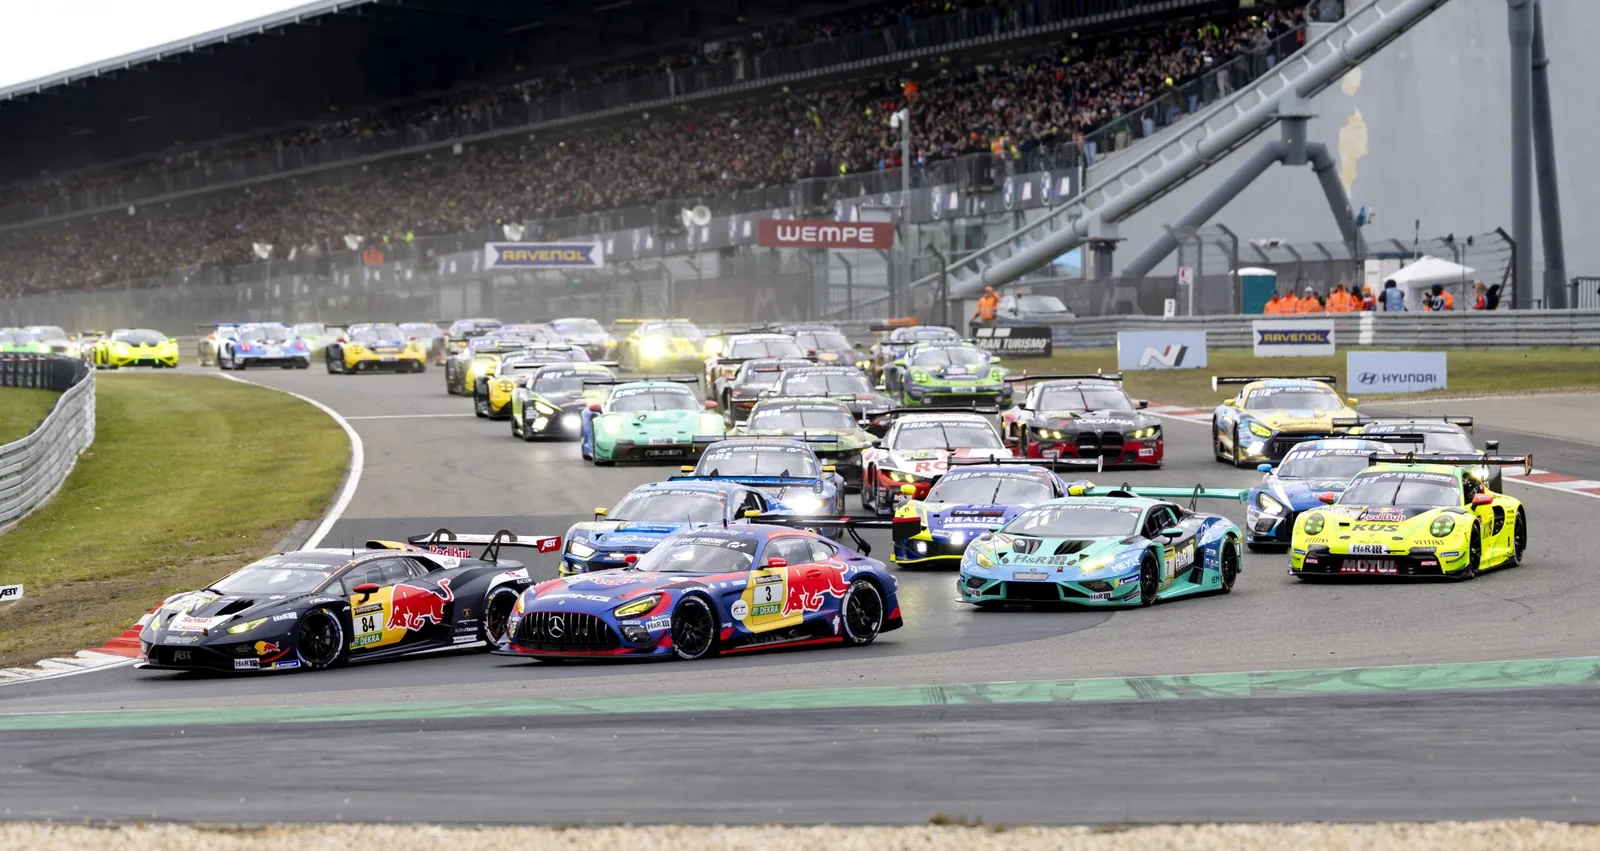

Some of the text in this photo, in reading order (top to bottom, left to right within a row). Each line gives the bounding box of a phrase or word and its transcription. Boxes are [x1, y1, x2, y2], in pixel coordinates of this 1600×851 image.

[777, 225, 874, 242] WEMPE
[502, 250, 587, 261] RAVENOL
[1003, 338, 1045, 349] TURISMO
[1264, 334, 1325, 342] RAVENOL
[1383, 373, 1437, 382] HYUNDAI
[1074, 418, 1135, 426] YOKOHAMA
[944, 516, 1006, 524] REALIZE
[541, 538, 557, 551] ABT
[1352, 544, 1371, 553] H&R
[1013, 555, 1046, 564] H&R
[1111, 556, 1140, 572] MEYLE
[1341, 559, 1398, 573] MOTUL
[0, 587, 18, 599] ABT
[765, 586, 772, 602] 3
[759, 605, 779, 615] DEKRA
[361, 615, 375, 633] 84
[647, 621, 661, 631] H&R
[360, 634, 380, 645] DEKRA
